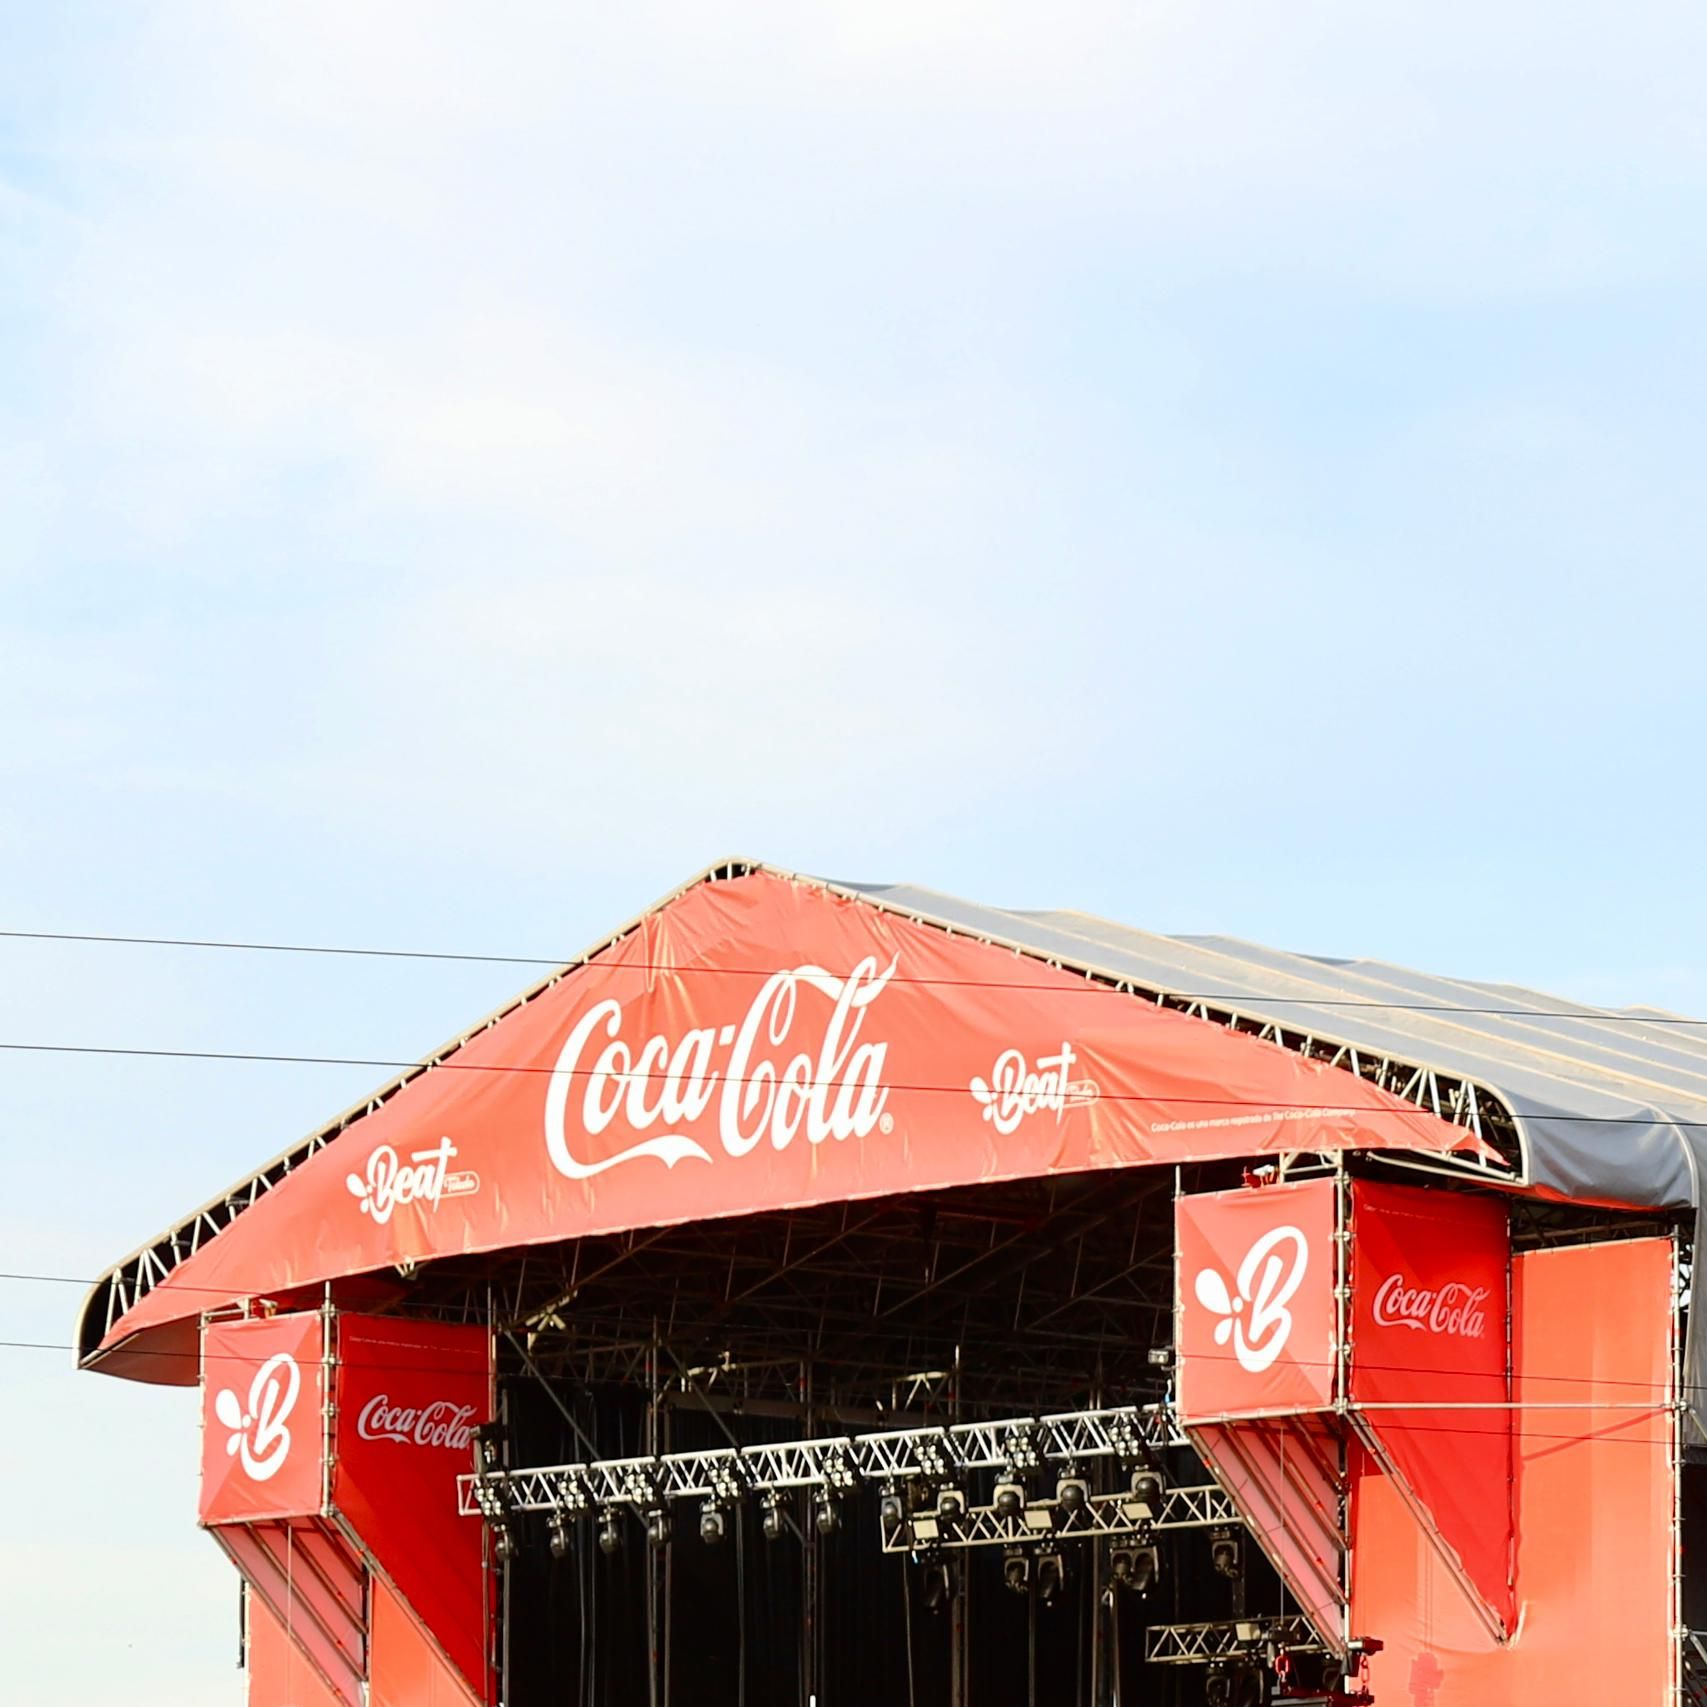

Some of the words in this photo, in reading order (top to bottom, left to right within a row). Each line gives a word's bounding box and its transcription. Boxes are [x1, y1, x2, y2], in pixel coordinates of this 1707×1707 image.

[545, 951, 900, 1180] Coca-Cola
[992, 1040, 1077, 1135] Beat
[366, 1136, 458, 1225] Beat
[1373, 1274, 1490, 1338] Coca-Cola
[357, 1394, 478, 1450] Coca-Cola
